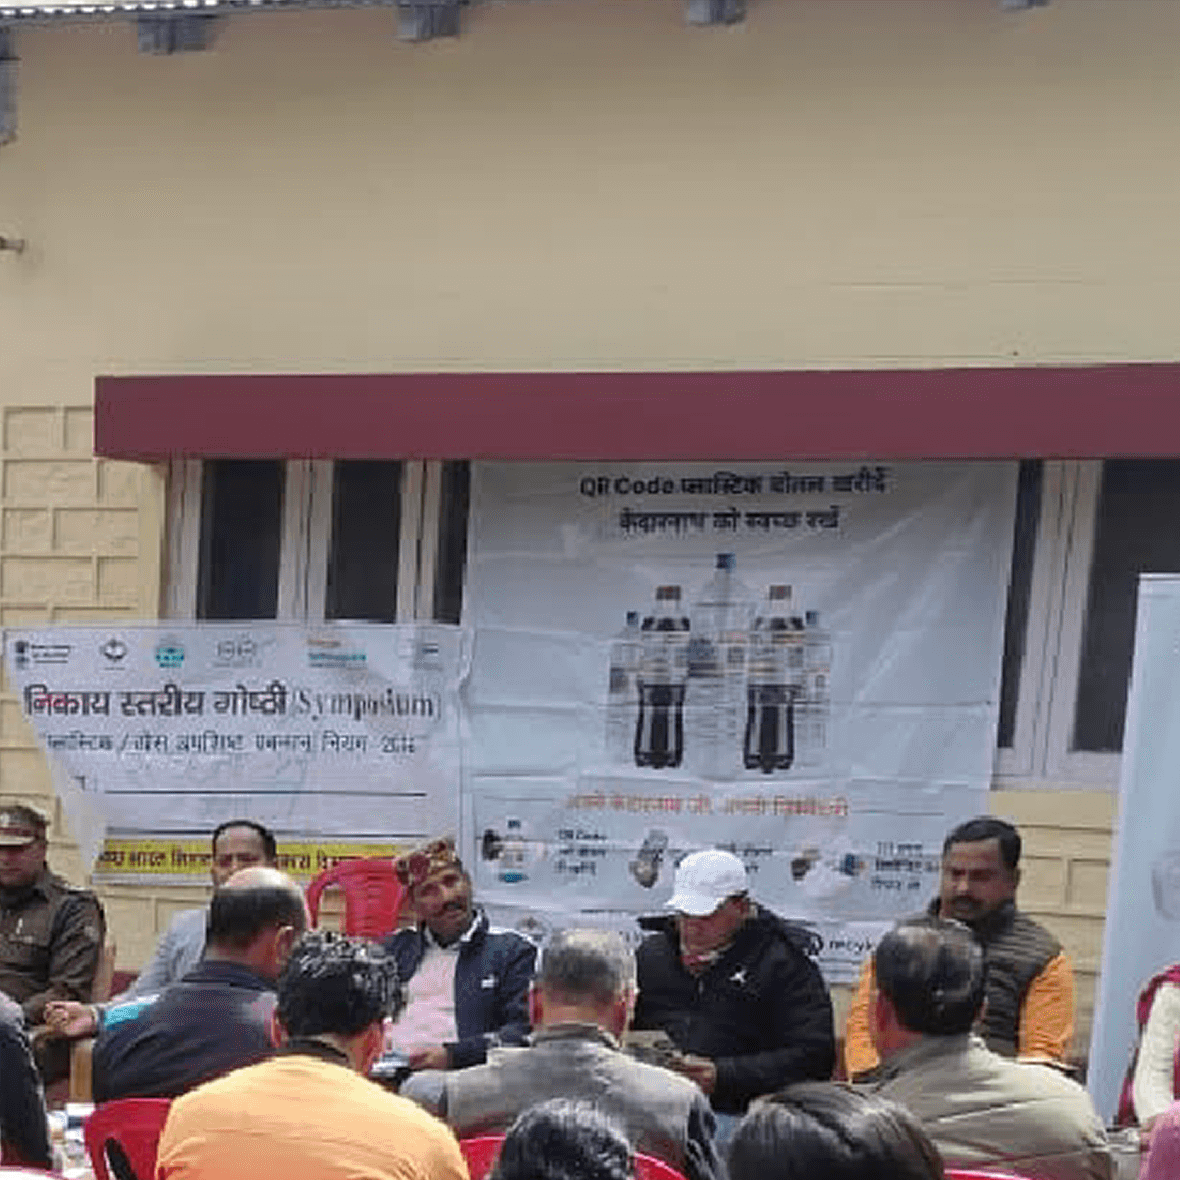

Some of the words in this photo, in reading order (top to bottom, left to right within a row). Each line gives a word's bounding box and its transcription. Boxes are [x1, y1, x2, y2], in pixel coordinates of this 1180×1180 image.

[580, 477, 609, 497] QR
[613, 475, 675, 495] Code
[681, 471, 762, 494] प्लास्टिक
[712, 506, 741, 531] को
[24, 684, 110, 716] निकाय
[120, 684, 205, 716] स्तरीय
[214, 680, 287, 716] गोष्ठी
